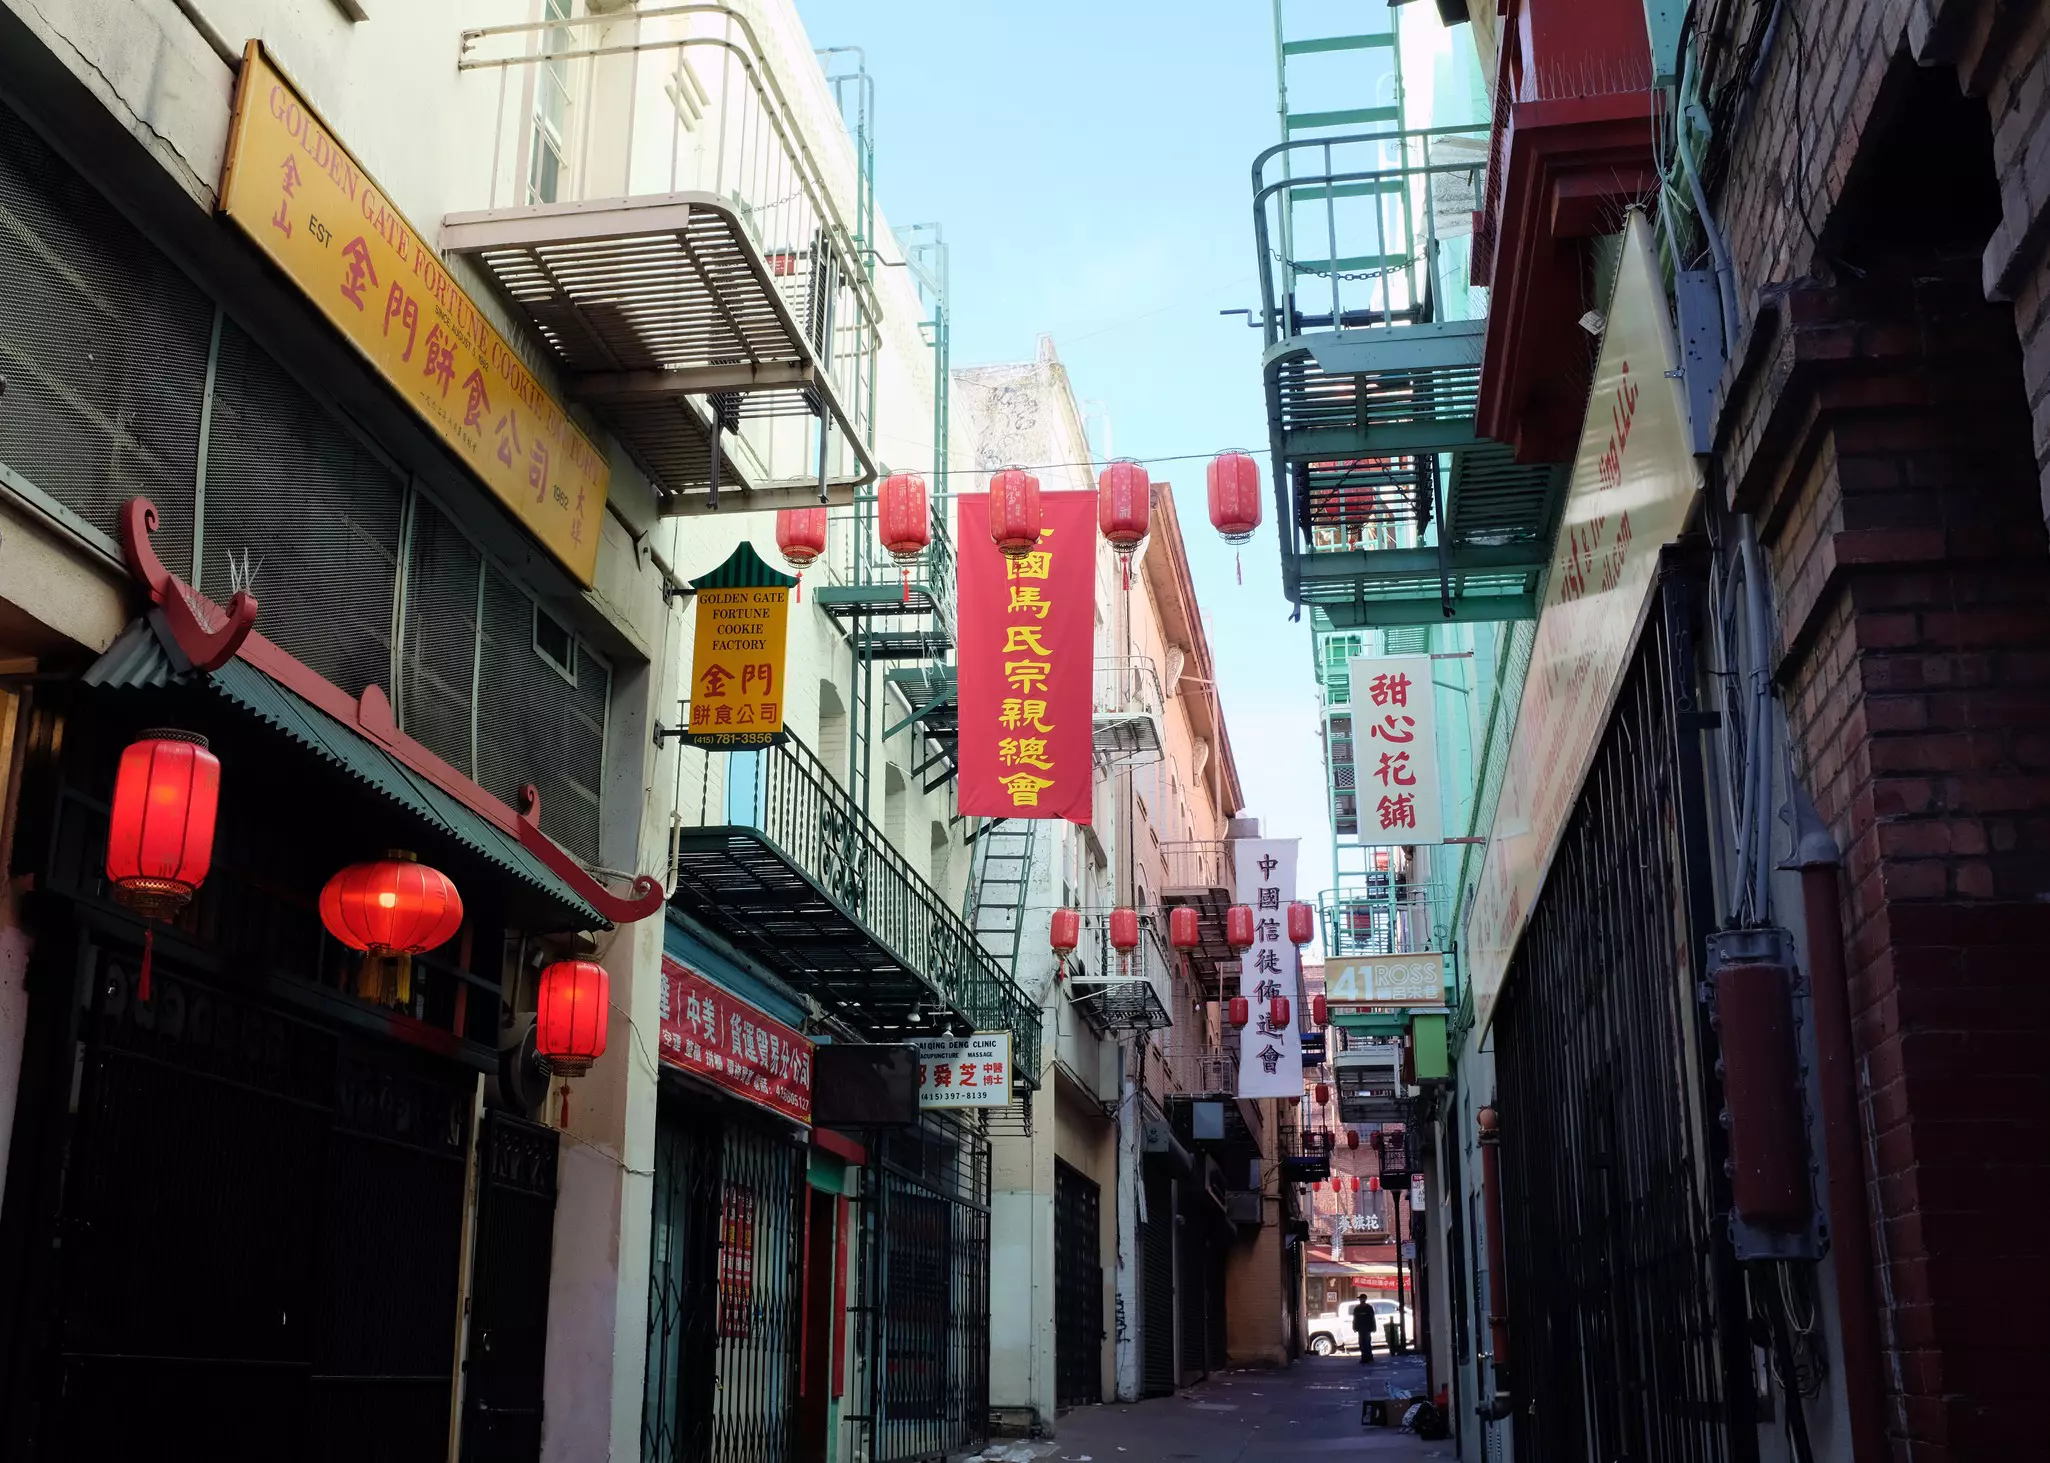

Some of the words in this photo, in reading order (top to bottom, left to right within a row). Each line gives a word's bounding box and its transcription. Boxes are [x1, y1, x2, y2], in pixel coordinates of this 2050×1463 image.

[272, 153, 303, 240] 金山
[308, 213, 333, 249] EST
[269, 85, 359, 201] GOLDEN
[361, 188, 410, 262] GATE
[413, 246, 489, 355] FORTUNE
[491, 337, 545, 421] COOKIE
[435, 304, 450, 327] SINCE
[452, 324, 471, 350] AUGUST
[340, 235, 551, 505] 金門餅食公司
[699, 592, 749, 605] GOLDEN
[753, 591, 785, 604] GATE
[712, 607, 770, 620] FORTUNE
[712, 639, 767, 651] FACTORY
[716, 623, 764, 635] COOKIE
[998, 508, 1056, 807] 國馬氏宗親總會
[700, 662, 773, 698] 金門
[692, 702, 778, 727] 餅食公司
[693, 735, 714, 745] (415)
[1368, 671, 1417, 831] 甜心花舖
[1332, 965, 1374, 1001] 41
[1375, 962, 1438, 986] ROSS
[949, 1041, 969, 1049] DENG
[972, 1040, 997, 1048] CLINIC
